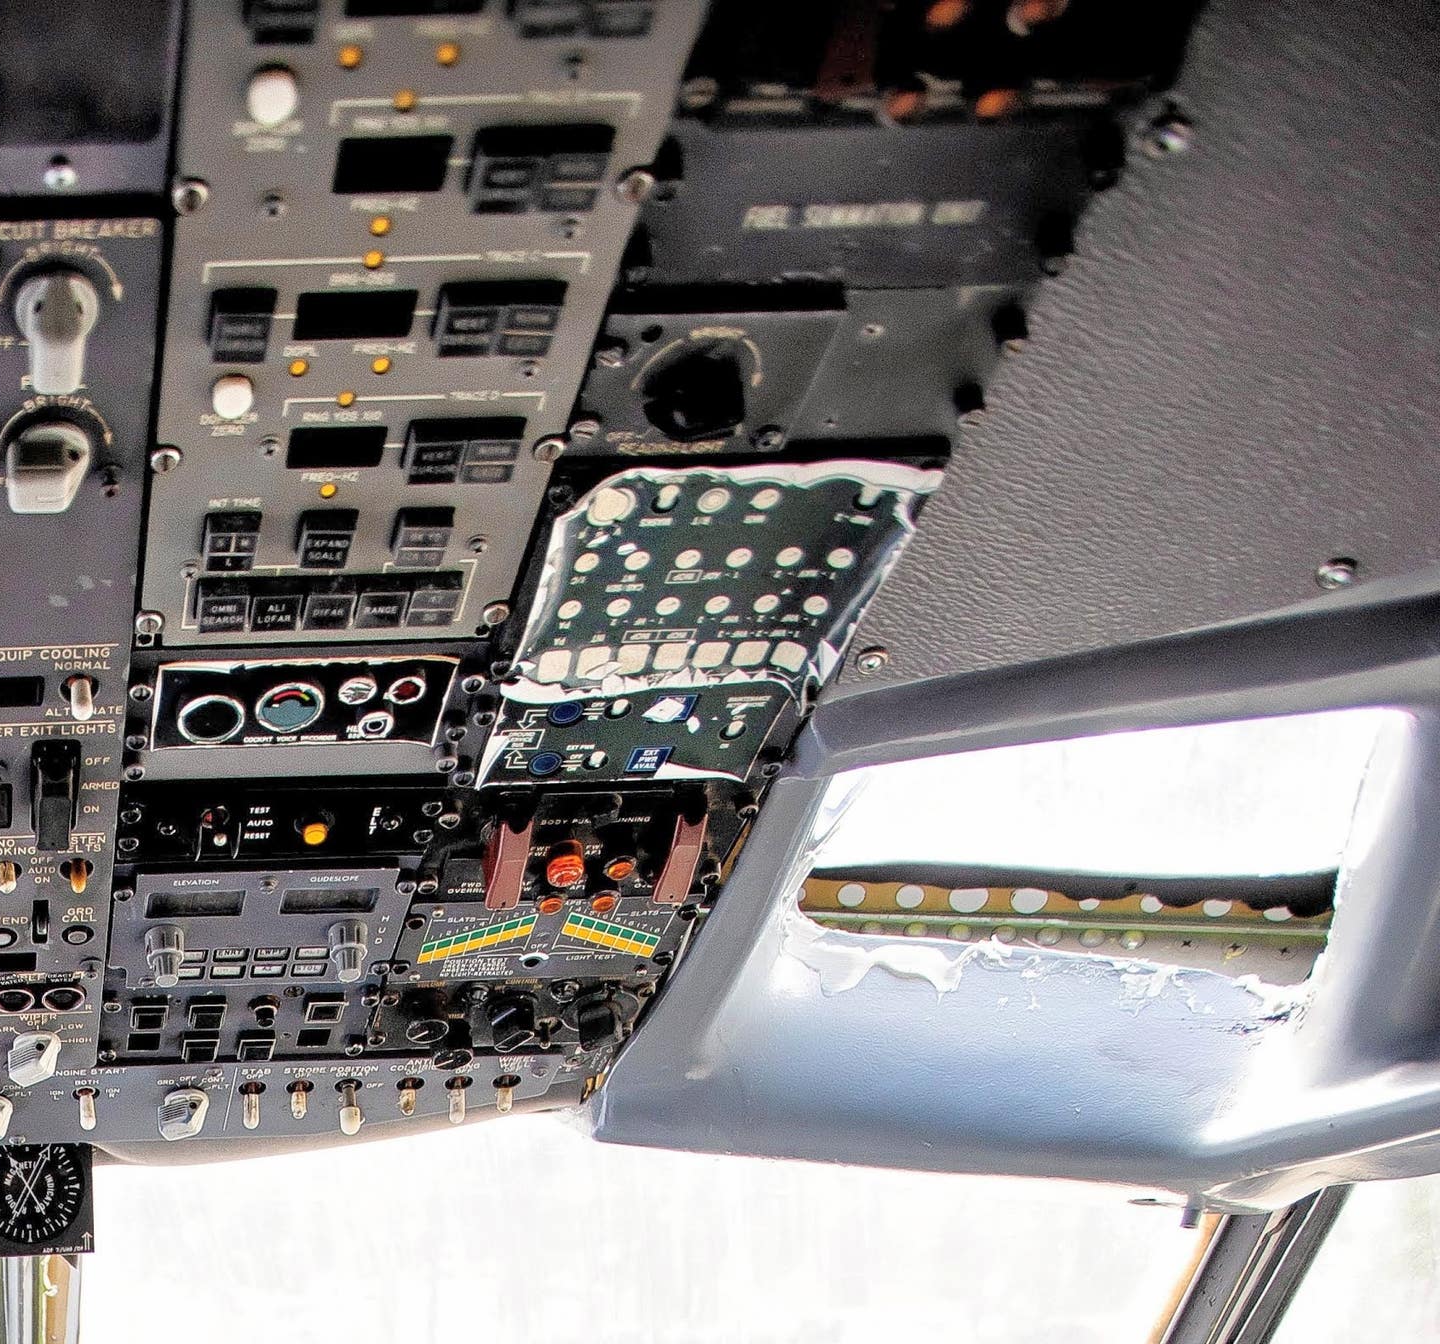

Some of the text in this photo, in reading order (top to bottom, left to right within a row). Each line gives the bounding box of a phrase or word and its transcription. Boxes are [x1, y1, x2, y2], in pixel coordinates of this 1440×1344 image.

[40, 648, 111, 660] COOLING
[54, 661, 111, 670] NORMAL
[20, 726, 53, 736] EXIT
[60, 723, 117, 735] LIGHTS
[84, 757, 111, 766] OFF
[81, 781, 120, 790] ARMED
[83, 805, 100, 813] ON
[248, 806, 271, 814] TEST
[247, 818, 274, 827] AUTO
[244, 831, 271, 840] RESET
[30, 856, 53, 865] OFF
[27, 866, 56, 874] AUTO
[34, 876, 51, 884] ON
[172, 878, 220, 886] ELEVATION
[67, 907, 94, 916] GRD
[61, 914, 98, 922] CALL
[483, 957, 510, 965] TEST
[18, 1013, 58, 1021] WIPER
[68, 1036, 92, 1044] HIGH
[90, 1067, 128, 1076] START
[241, 1067, 272, 1075] STAB
[284, 1065, 380, 1074] STROBE POSITION
